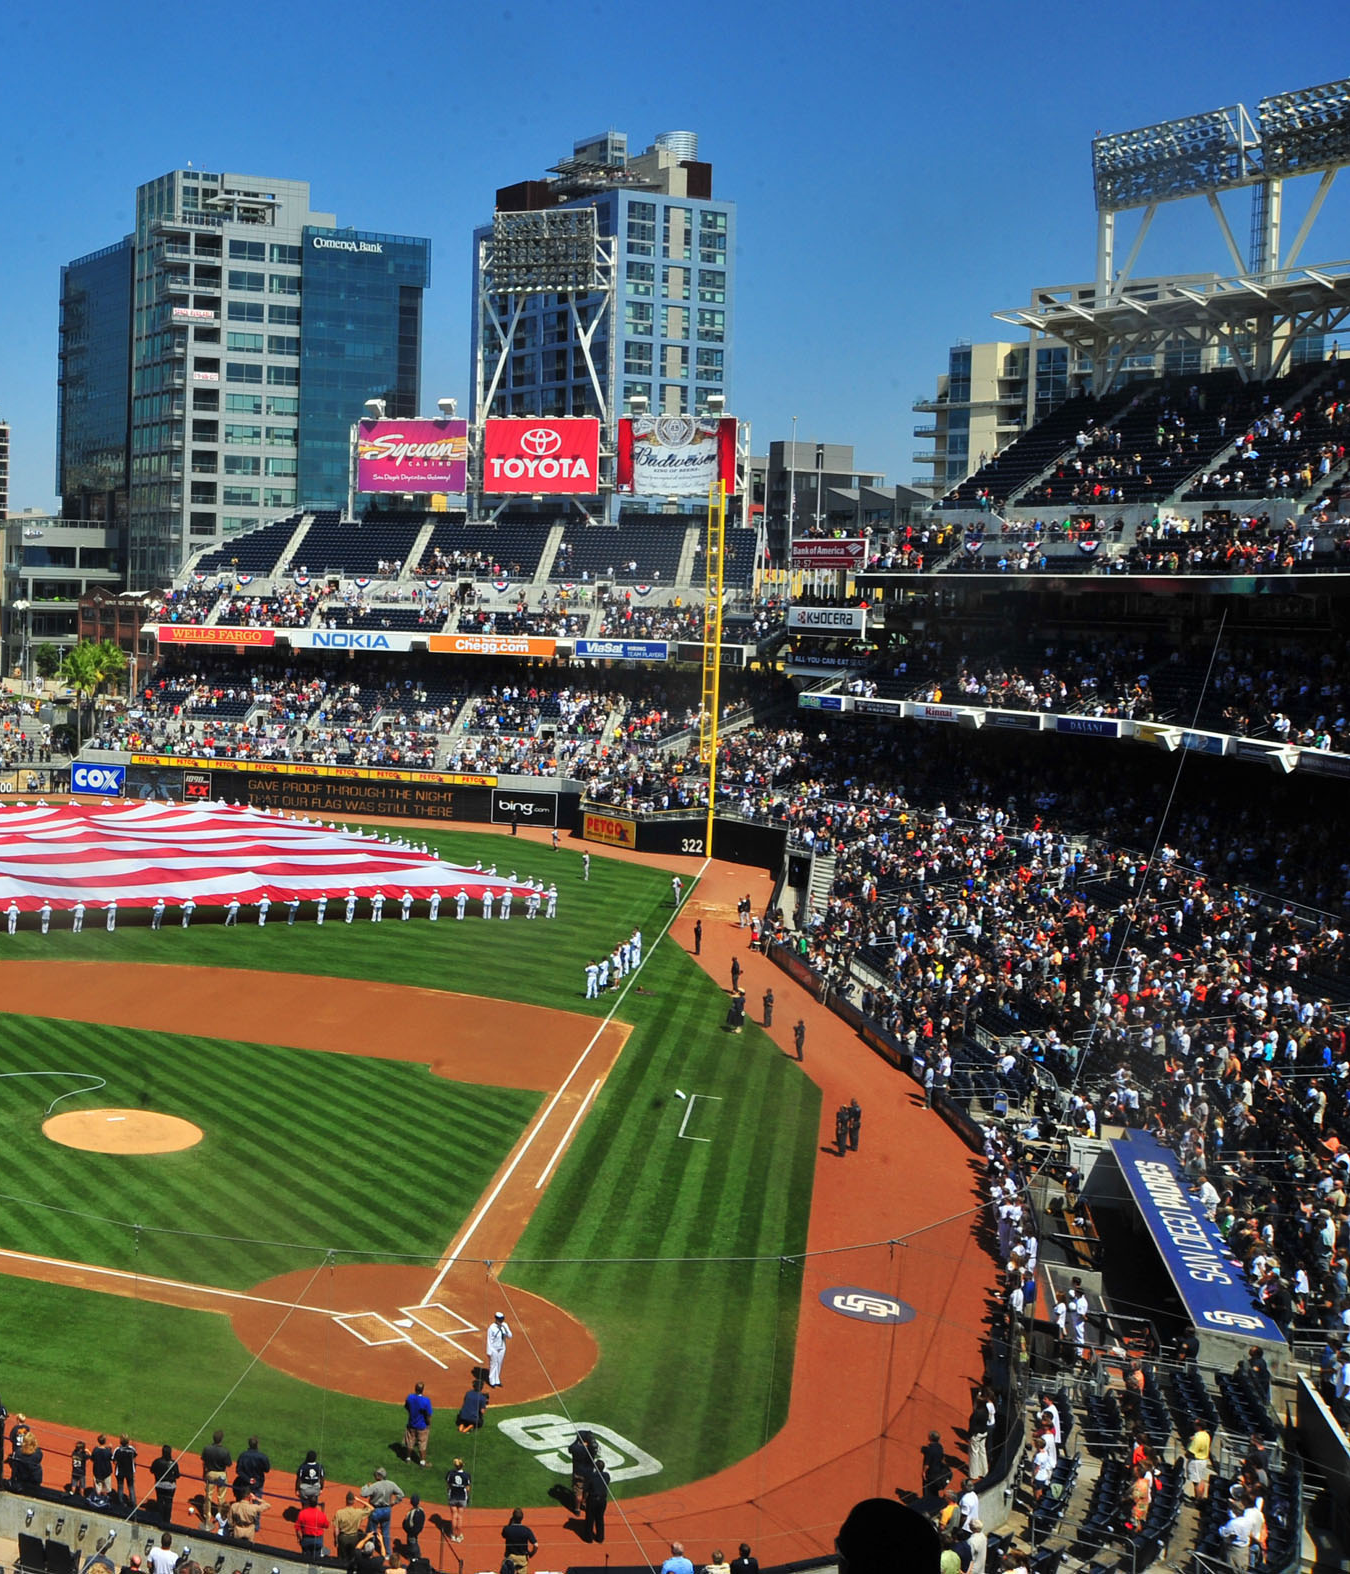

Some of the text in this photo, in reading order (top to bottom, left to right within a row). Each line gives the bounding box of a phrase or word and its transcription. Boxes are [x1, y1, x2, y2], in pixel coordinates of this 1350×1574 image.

[360, 242, 383, 253] Bank
[364, 434, 461, 466] Sycuan
[633, 446, 717, 467] Budweiser
[491, 457, 590, 478] TOYOTA
[793, 546, 845, 555] Bank of America
[172, 629, 262, 641] WELLS FARGO
[312, 632, 390, 648] NOKIA
[455, 639, 529, 653] Chegg.com
[586, 642, 624, 653] ViaSat
[925, 707, 953, 717] Rinnai
[1070, 721, 1103, 733] DASANI
[295, 766, 316, 774] PETCO
[336, 769, 356, 777] PETCO
[377, 771, 398, 779] PETCO
[75, 769, 120, 791] COX
[420, 774, 441, 782] PETCO
[186, 785, 209, 796] XX
[249, 780, 454, 803] GAVE PROOF THROUGH THE NIGHT
[282, 795, 308, 807] OUR
[311, 798, 342, 809] FLAG
[345, 801, 375, 812] WAS
[378, 803, 410, 815] STILL
[414, 805, 454, 817] THERE
[587, 817, 622, 835] PETCO
[682, 839, 703, 853] 322
[1134, 1160, 1233, 1285] SAN DIEGO PADRES
